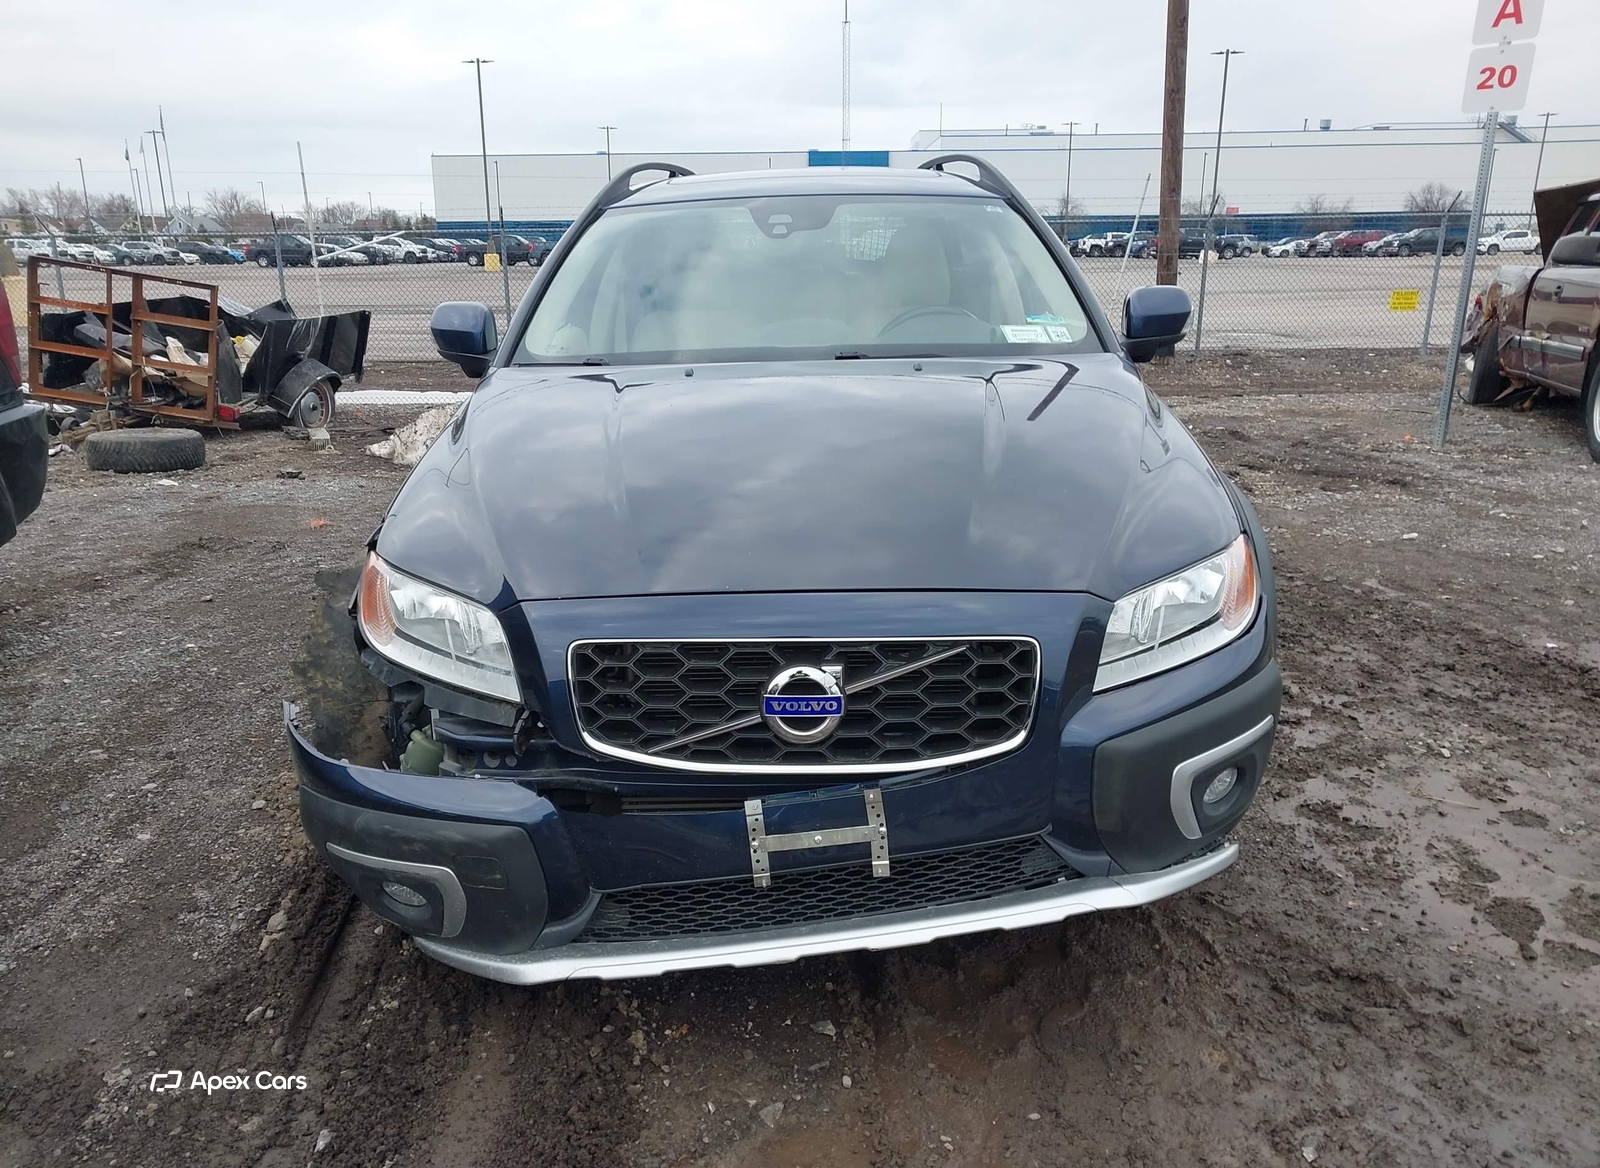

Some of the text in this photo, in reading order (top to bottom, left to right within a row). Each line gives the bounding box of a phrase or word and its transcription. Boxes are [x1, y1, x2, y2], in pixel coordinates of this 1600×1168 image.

[1491, 0, 1523, 28] A
[1476, 65, 1517, 90] 20
[769, 700, 838, 711] VOLVO
